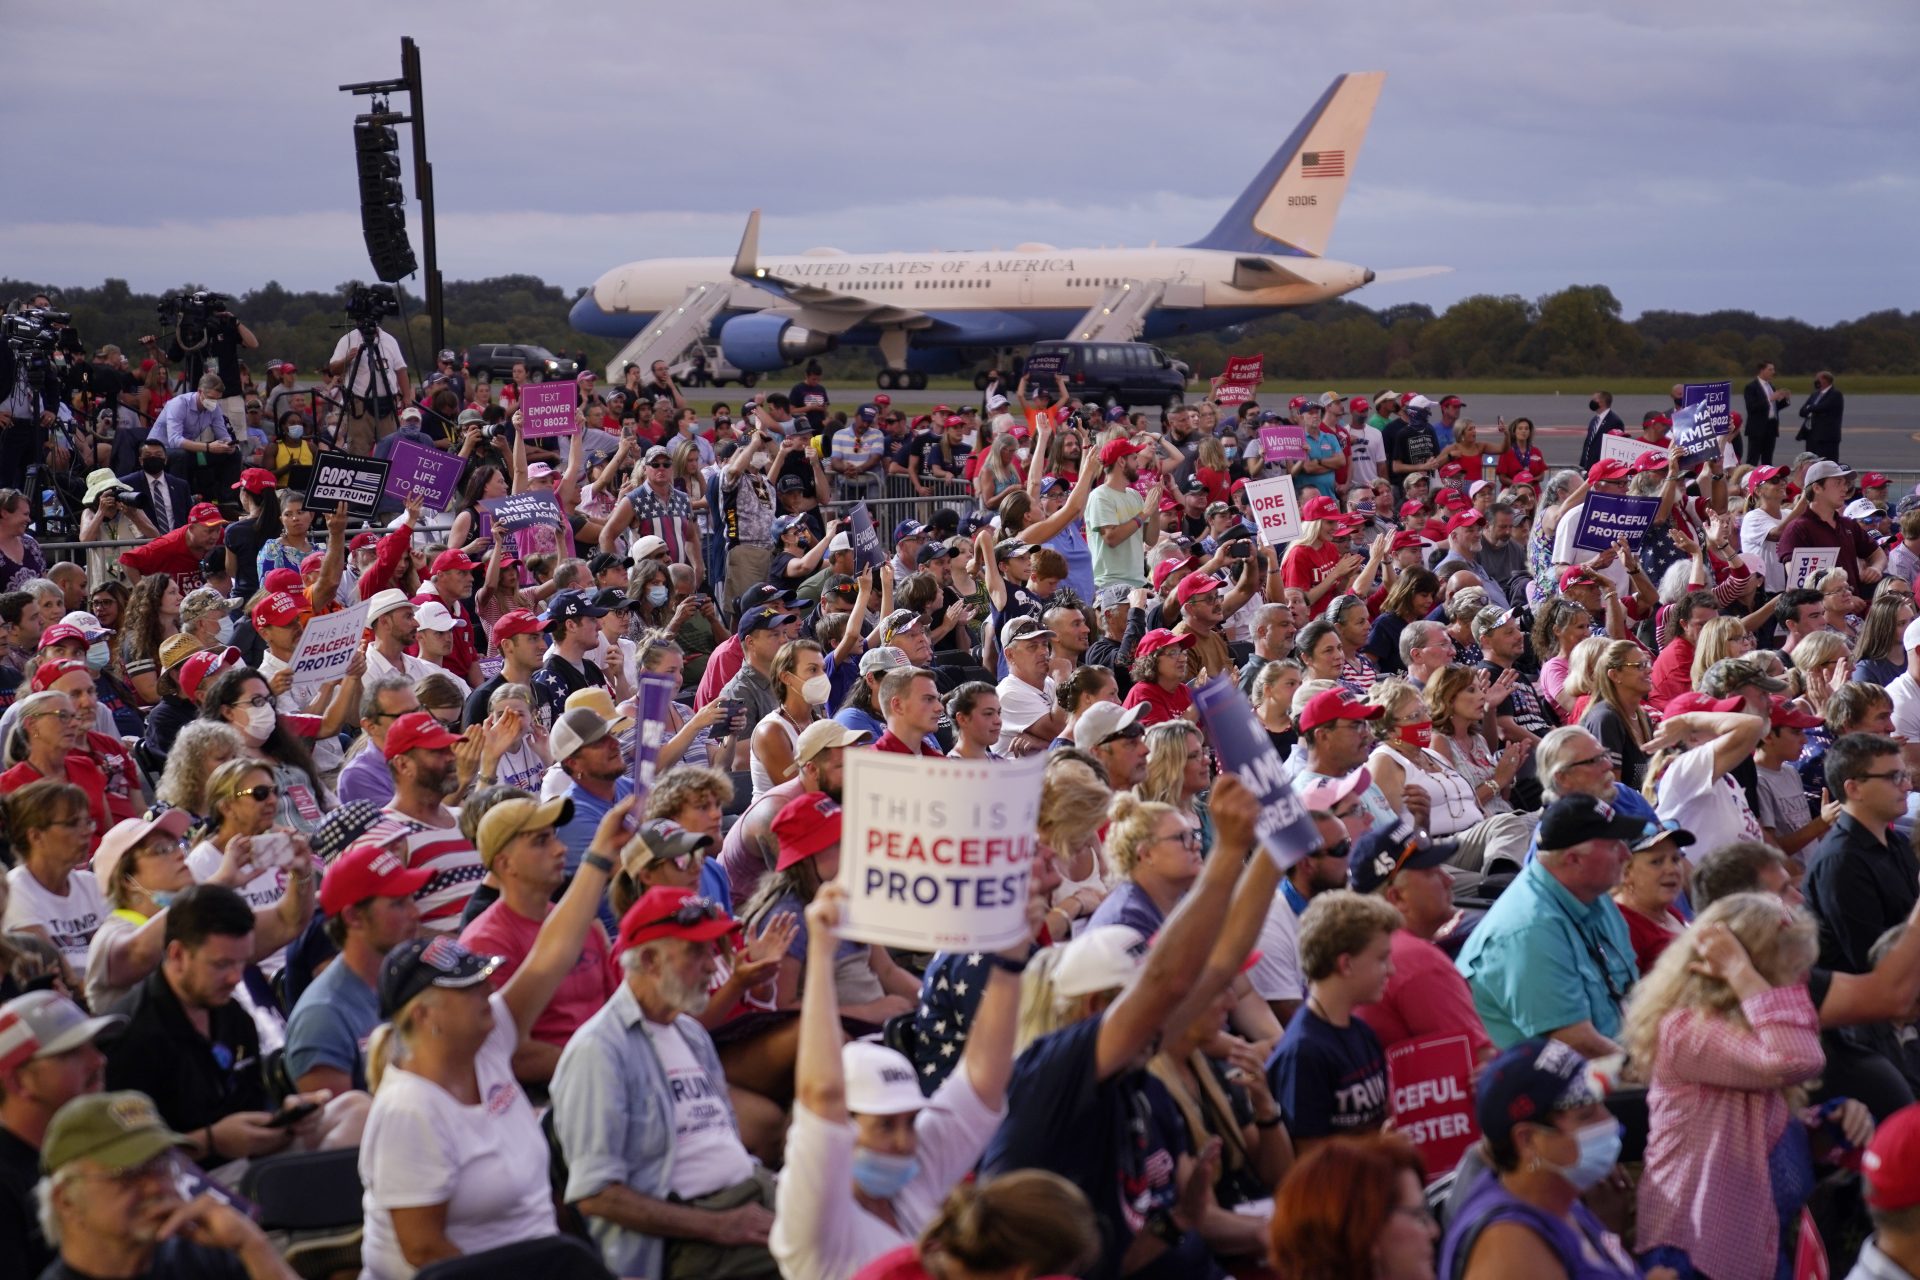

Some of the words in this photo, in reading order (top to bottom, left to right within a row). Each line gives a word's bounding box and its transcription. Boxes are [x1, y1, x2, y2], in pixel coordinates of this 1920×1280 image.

[1288, 195, 1318, 206] 90015
[775, 262, 851, 277] UNITED
[856, 261, 932, 275] STATES
[941, 260, 968, 273] OF
[975, 258, 1076, 273] AMERICA
[1240, 361, 1260, 371] MORE
[1231, 371, 1258, 379] YEARS!
[539, 392, 561, 402] TEXT
[1216, 386, 1251, 396] AMERICA
[1705, 391, 1725, 402] TEXT
[528, 404, 571, 416] EMPOWER
[531, 418, 542, 428] TO
[543, 416, 568, 427] 88022
[1266, 435, 1302, 447] Women
[1611, 447, 1636, 461] THIS
[418, 456, 444, 471] TEXT
[318, 466, 355, 487] COPS
[413, 470, 437, 484] LIFE
[316, 487, 335, 497] FOR
[339, 489, 374, 503] TRUMP
[395, 477, 411, 490] TO
[412, 484, 442, 500] 88022
[505, 495, 536, 506] MAKE
[494, 500, 560, 516] AMERICA
[498, 512, 533, 525] GREAT
[1591, 510, 1648, 526] PEACEFUL
[1587, 525, 1643, 539] PROTESTER
[565, 603, 578, 616] 45
[310, 627, 337, 642] THIS
[341, 623, 351, 634] IS
[302, 633, 356, 657] PEACEFUL
[294, 648, 354, 673] PROTEST
[868, 793, 947, 829] THIS
[972, 801, 1008, 831] IS
[1373, 849, 1397, 877] 45
